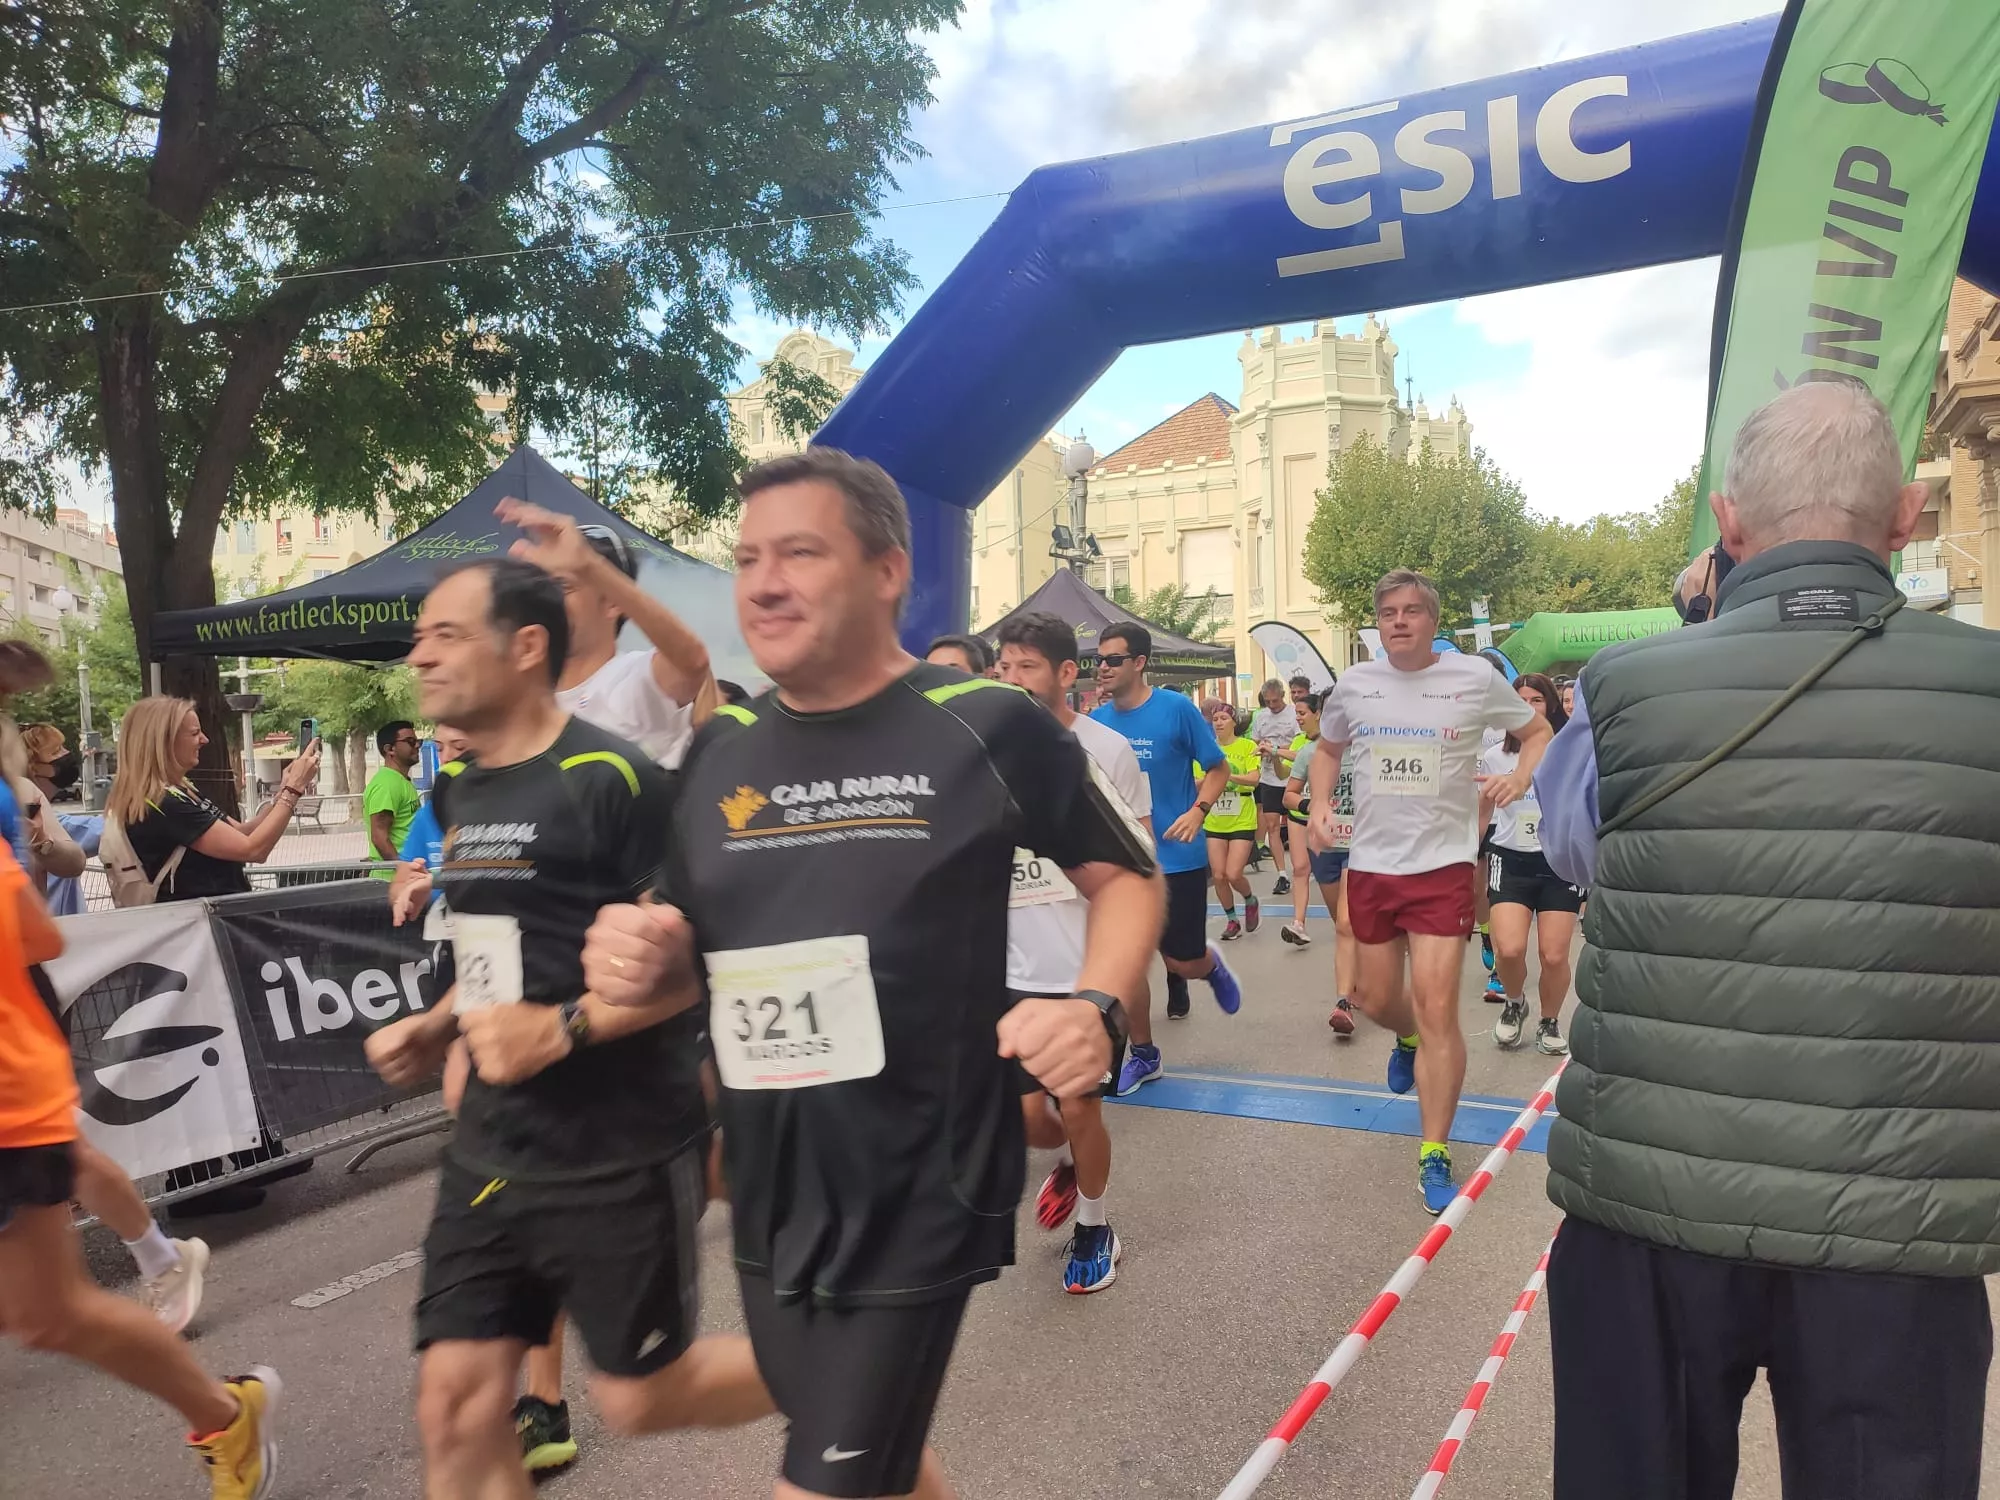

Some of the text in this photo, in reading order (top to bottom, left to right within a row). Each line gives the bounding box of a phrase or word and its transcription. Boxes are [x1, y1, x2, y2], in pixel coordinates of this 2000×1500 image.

[1816, 145, 1910, 279] VIP
[1562, 623, 1636, 643] FARTLECK
[1379, 725, 1436, 738] mueves
[1381, 757, 1423, 775] 346
[261, 952, 438, 1042] iber
[730, 991, 819, 1043] 321
